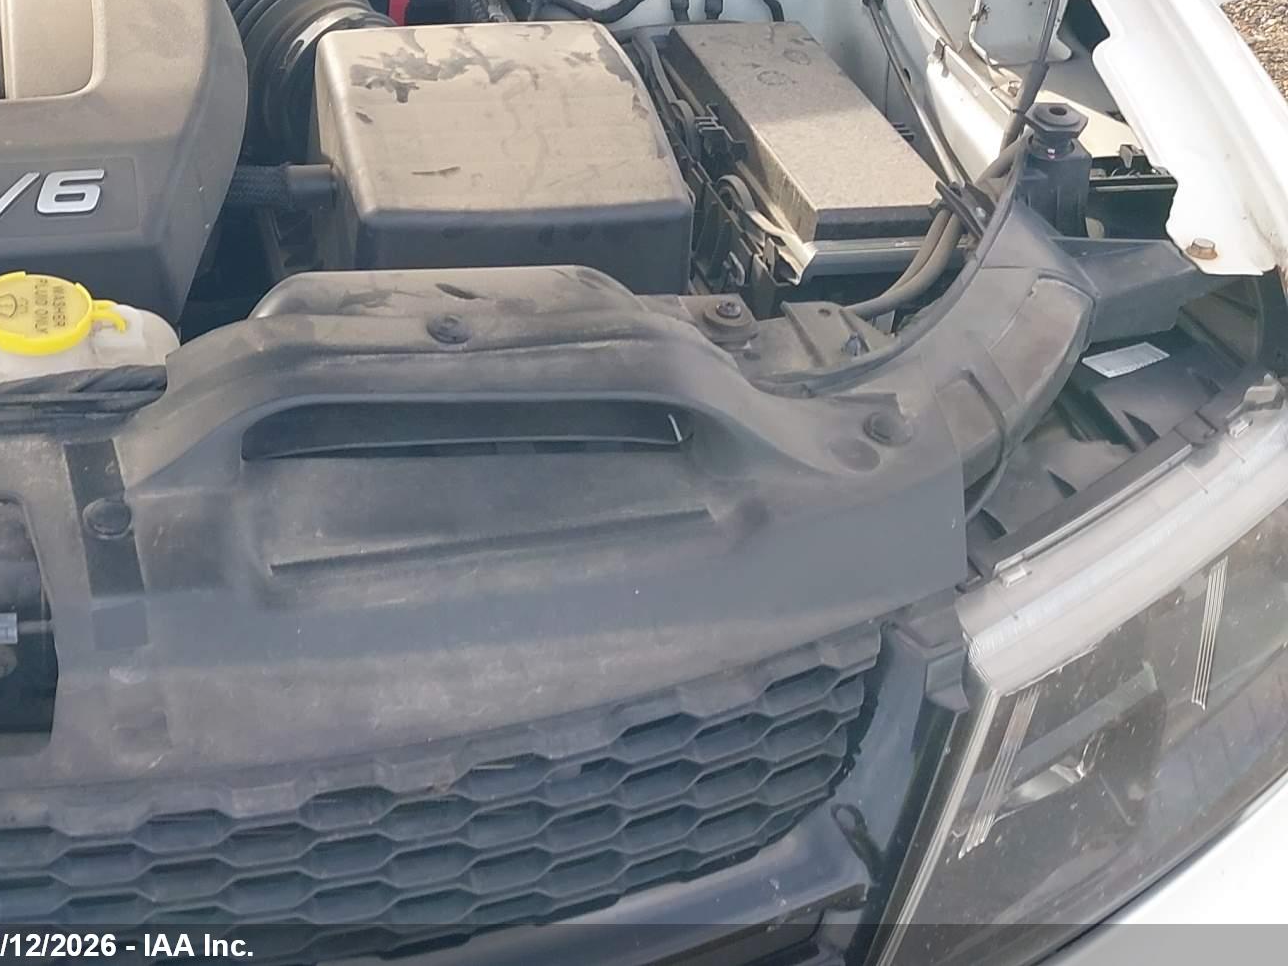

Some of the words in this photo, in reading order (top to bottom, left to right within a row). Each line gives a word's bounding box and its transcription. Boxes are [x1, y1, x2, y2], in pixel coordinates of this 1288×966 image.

[34, 278, 49, 306] FLUID
[34, 307, 49, 334] ONLY
[52, 285, 66, 328] WASHER
